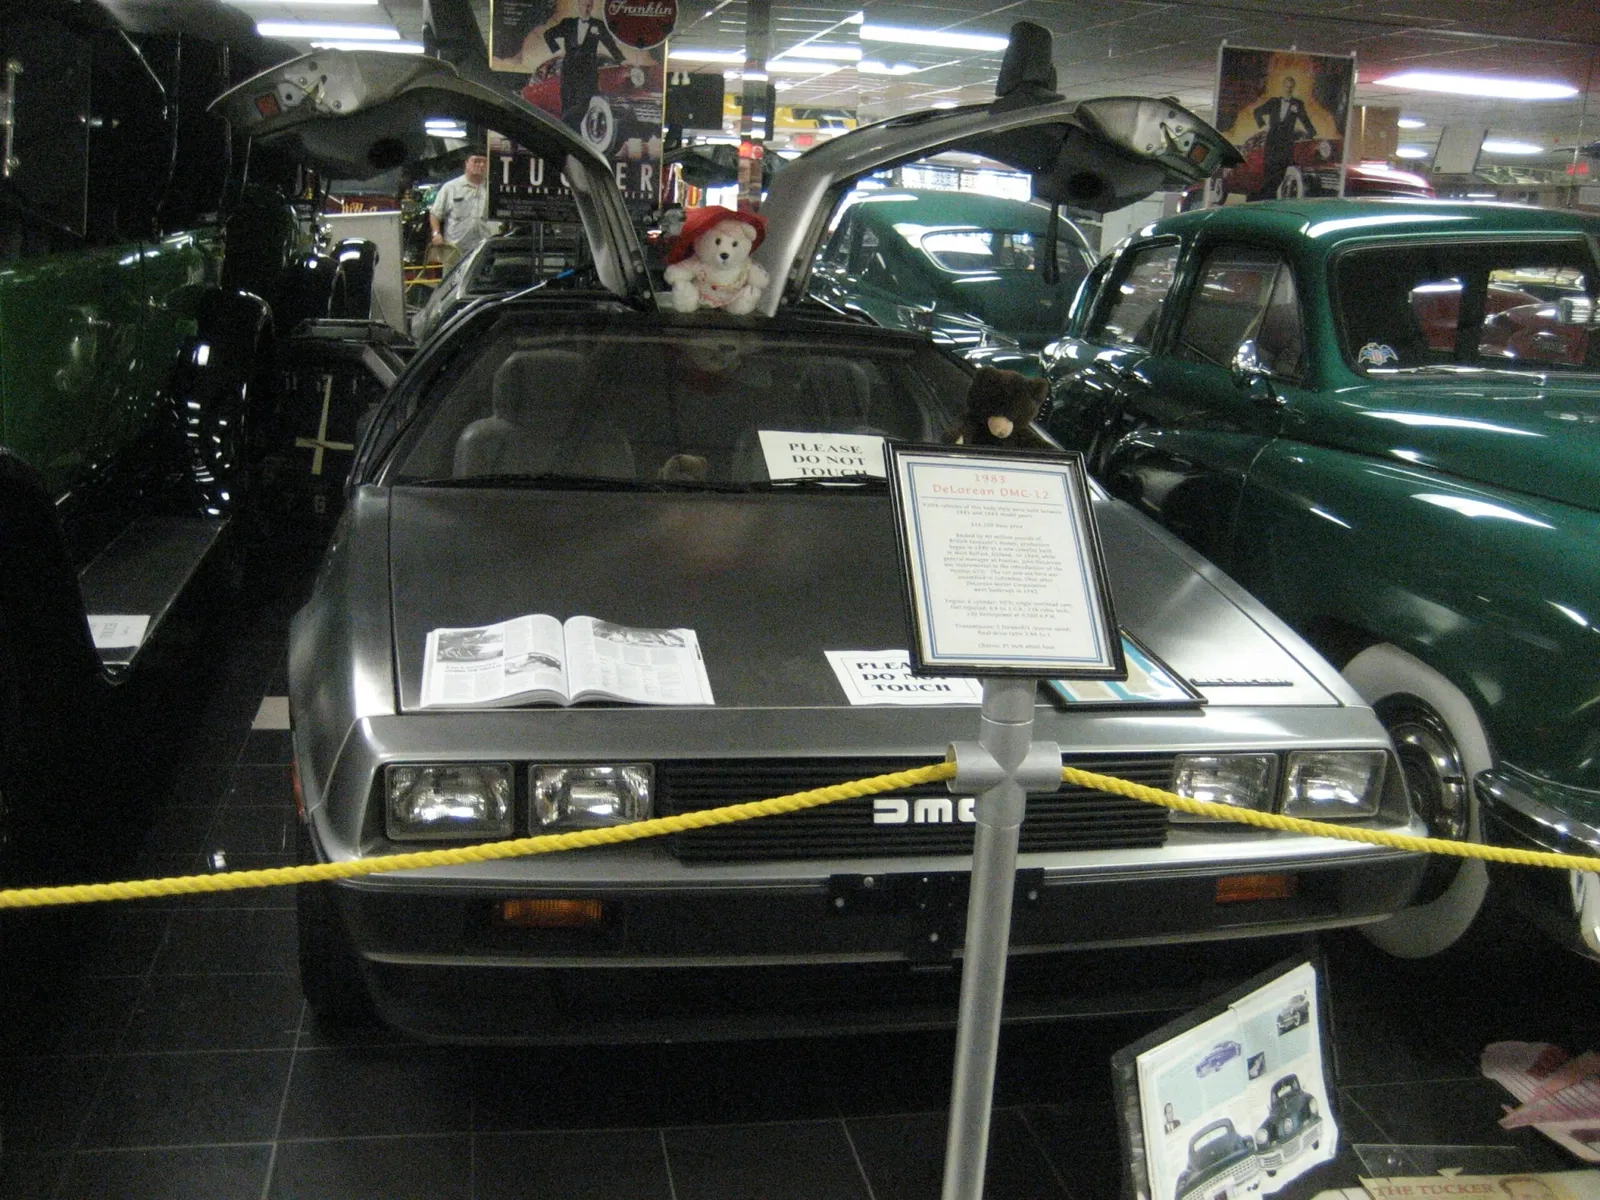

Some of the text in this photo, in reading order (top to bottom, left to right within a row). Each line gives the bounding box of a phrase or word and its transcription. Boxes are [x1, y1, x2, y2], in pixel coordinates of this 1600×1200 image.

[608, 1, 672, 16] Franklin
[500, 156, 654, 192] TUER
[788, 442, 864, 454] PLEASE
[792, 454, 866, 466] DO NOT
[797, 466, 868, 478] TOUCH
[974, 474, 1006, 484] 1983
[932, 484, 1050, 500] DeLorean DMC-12
[856, 662, 912, 670] PLEA
[862, 673, 896, 681] DO
[872, 684, 952, 692] TOUCH
[1373, 1182, 1496, 1197] THE TUCKER
